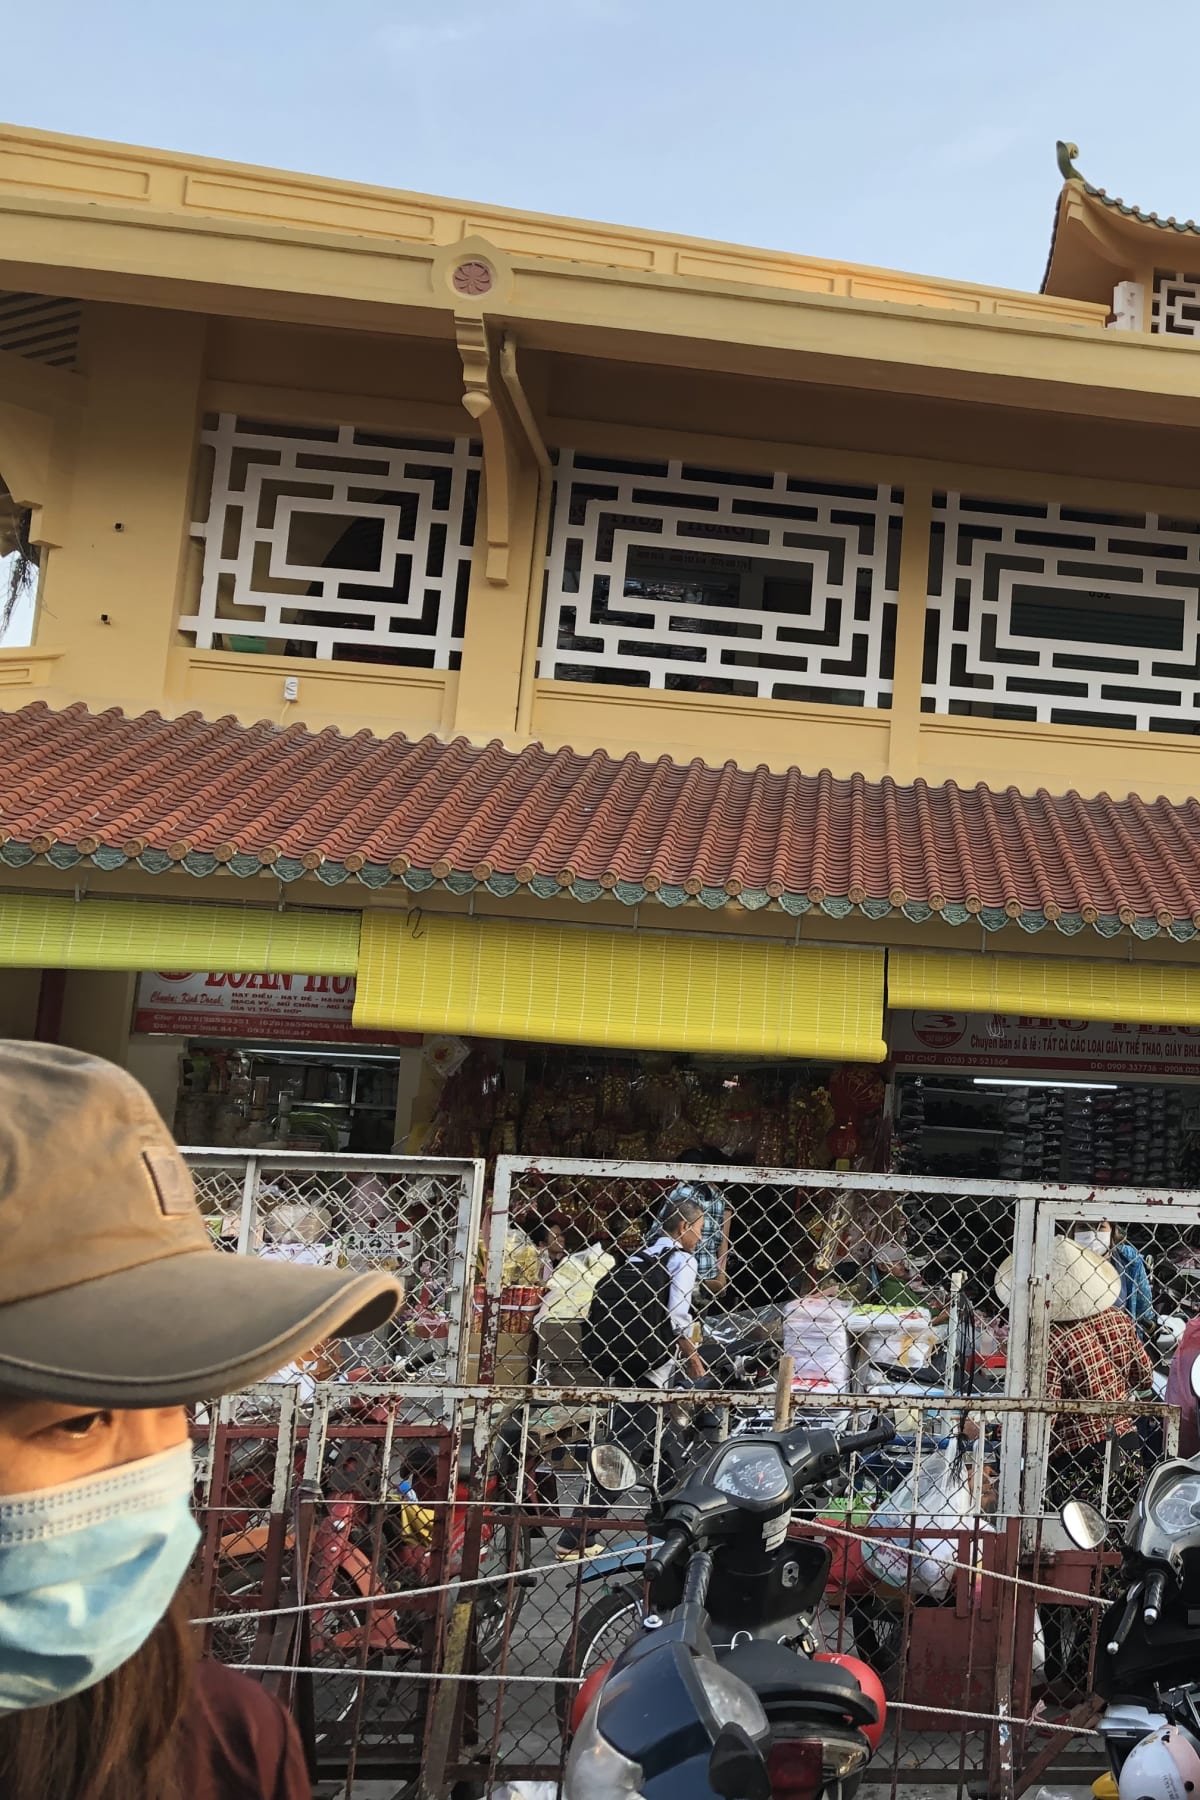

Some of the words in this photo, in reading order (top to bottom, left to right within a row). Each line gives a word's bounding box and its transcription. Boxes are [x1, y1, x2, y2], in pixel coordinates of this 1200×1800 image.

[1070, 1035, 1086, 1052] CÁC
[1087, 1039, 1104, 1057] LOẠI
[1125, 1035, 1140, 1055] THỂ
[1142, 1041, 1163, 1058] THAO,
